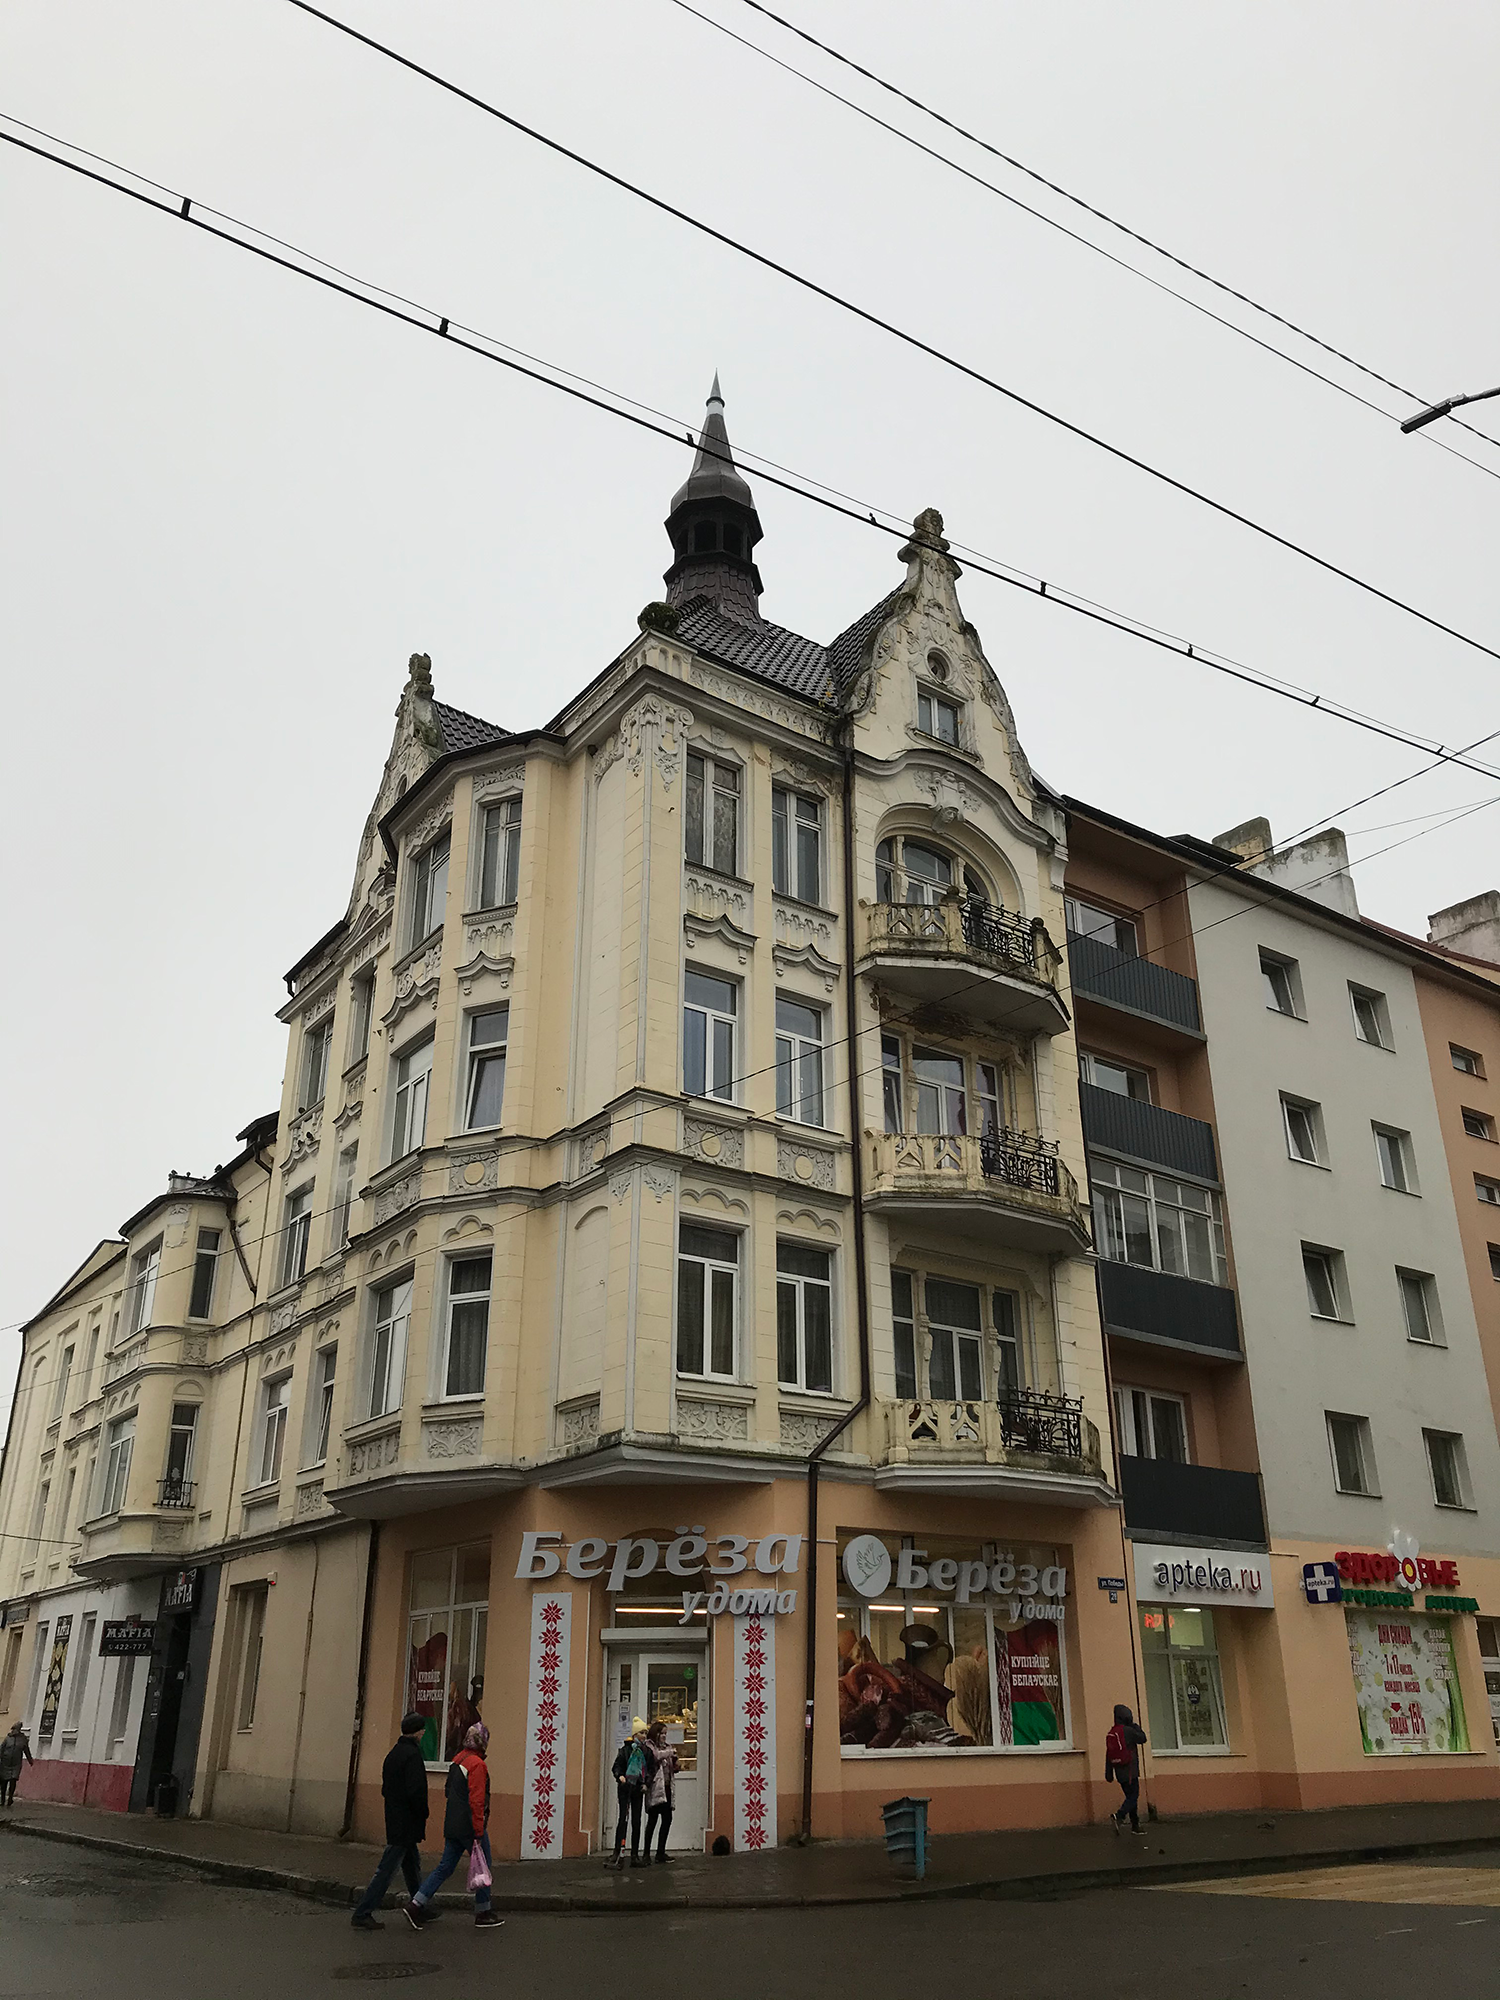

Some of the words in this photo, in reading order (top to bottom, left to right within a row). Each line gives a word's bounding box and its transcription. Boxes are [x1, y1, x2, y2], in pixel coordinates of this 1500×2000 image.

[513, 1525, 803, 1592] Берёза
[896, 1550, 1067, 1603] Берёза
[1155, 1557, 1263, 1593] apteka.ru
[164, 1584, 193, 1606] MAFIA
[678, 1590, 706, 1625] у
[706, 1580, 799, 1616] дома
[1009, 1601, 1022, 1623] у
[1024, 1597, 1066, 1620] дома
[105, 1628, 152, 1638] MAFIA
